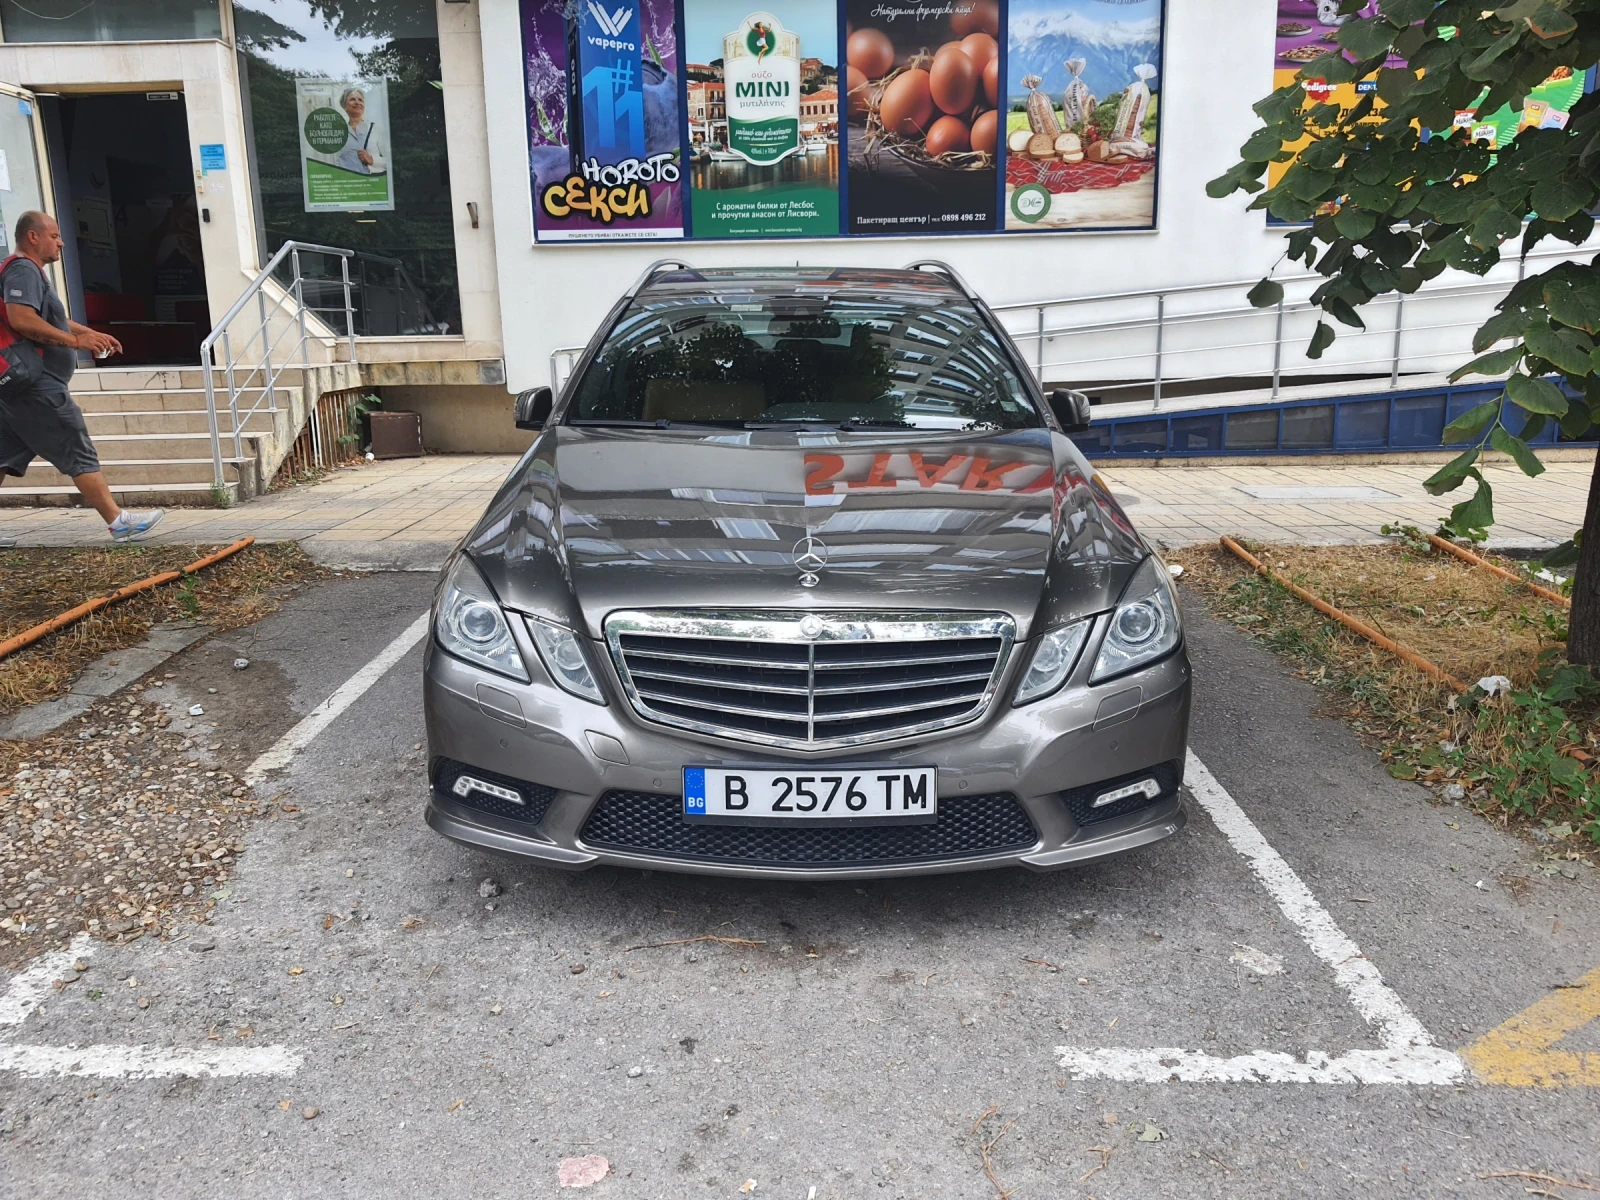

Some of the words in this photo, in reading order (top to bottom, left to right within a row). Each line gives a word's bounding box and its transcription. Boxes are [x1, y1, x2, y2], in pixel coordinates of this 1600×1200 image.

[587, 36, 635, 52] vapepro
[735, 81, 790, 98] MINI
[544, 176, 648, 222] СЕКСИ
[716, 202, 721, 211] С
[722, 203, 755, 212] ароматни
[757, 202, 778, 210] билки
[789, 201, 814, 209] Лесбос
[717, 211, 750, 220] прочутия
[787, 209, 819, 218] Лисвори.
[856, 216, 898, 225] Пакетиращ
[899, 215, 927, 224] център
[941, 214, 959, 222] 0898
[960, 213, 974, 221] 496
[974, 213, 986, 221] 212
[724, 775, 749, 810] B
[771, 776, 867, 812] 2576
[876, 774, 927, 810] TM
[687, 797, 704, 808] BG
